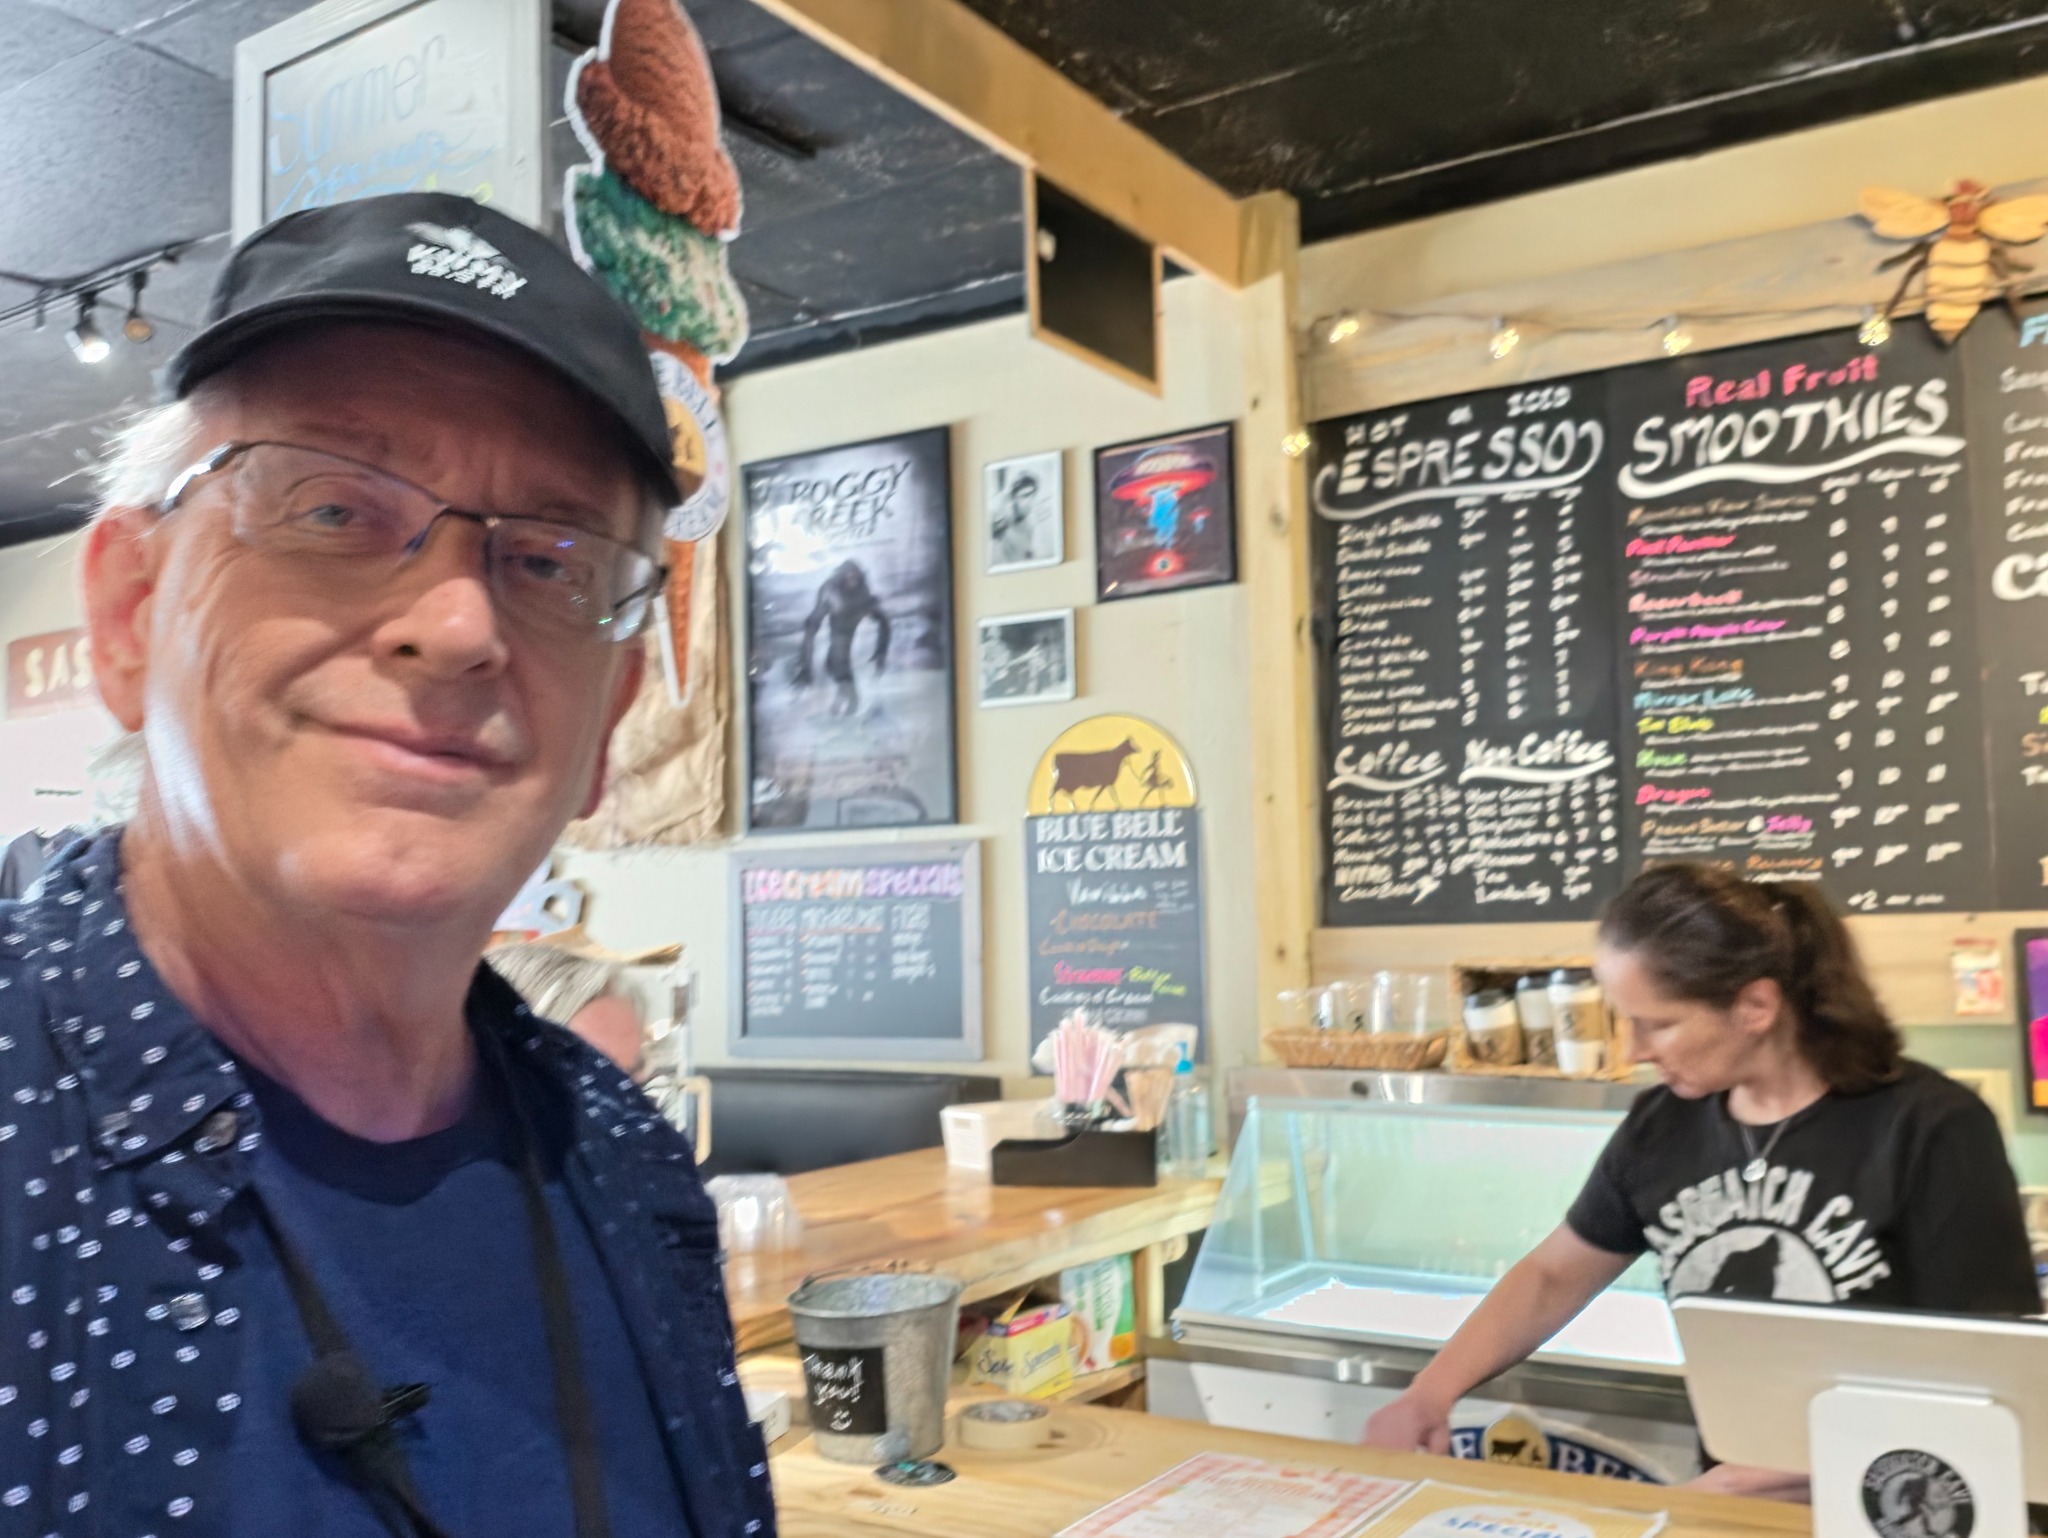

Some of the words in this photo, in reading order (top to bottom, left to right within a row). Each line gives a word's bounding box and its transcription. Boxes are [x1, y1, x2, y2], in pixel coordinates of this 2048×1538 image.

[1685, 369, 1772, 409] Real
[1781, 353, 1879, 397] Fruit
[1632, 377, 1948, 476] SMOOTHIES
[1337, 420, 1576, 494] ESPRESSO
[1334, 740, 1442, 775] Coffee
[1037, 811, 1110, 843] BLUE
[1112, 807, 1184, 840] BELL
[1037, 846, 1086, 873] ICE
[1084, 841, 1188, 872] CREAM
[1802, 1195, 1892, 1301] CAVE
